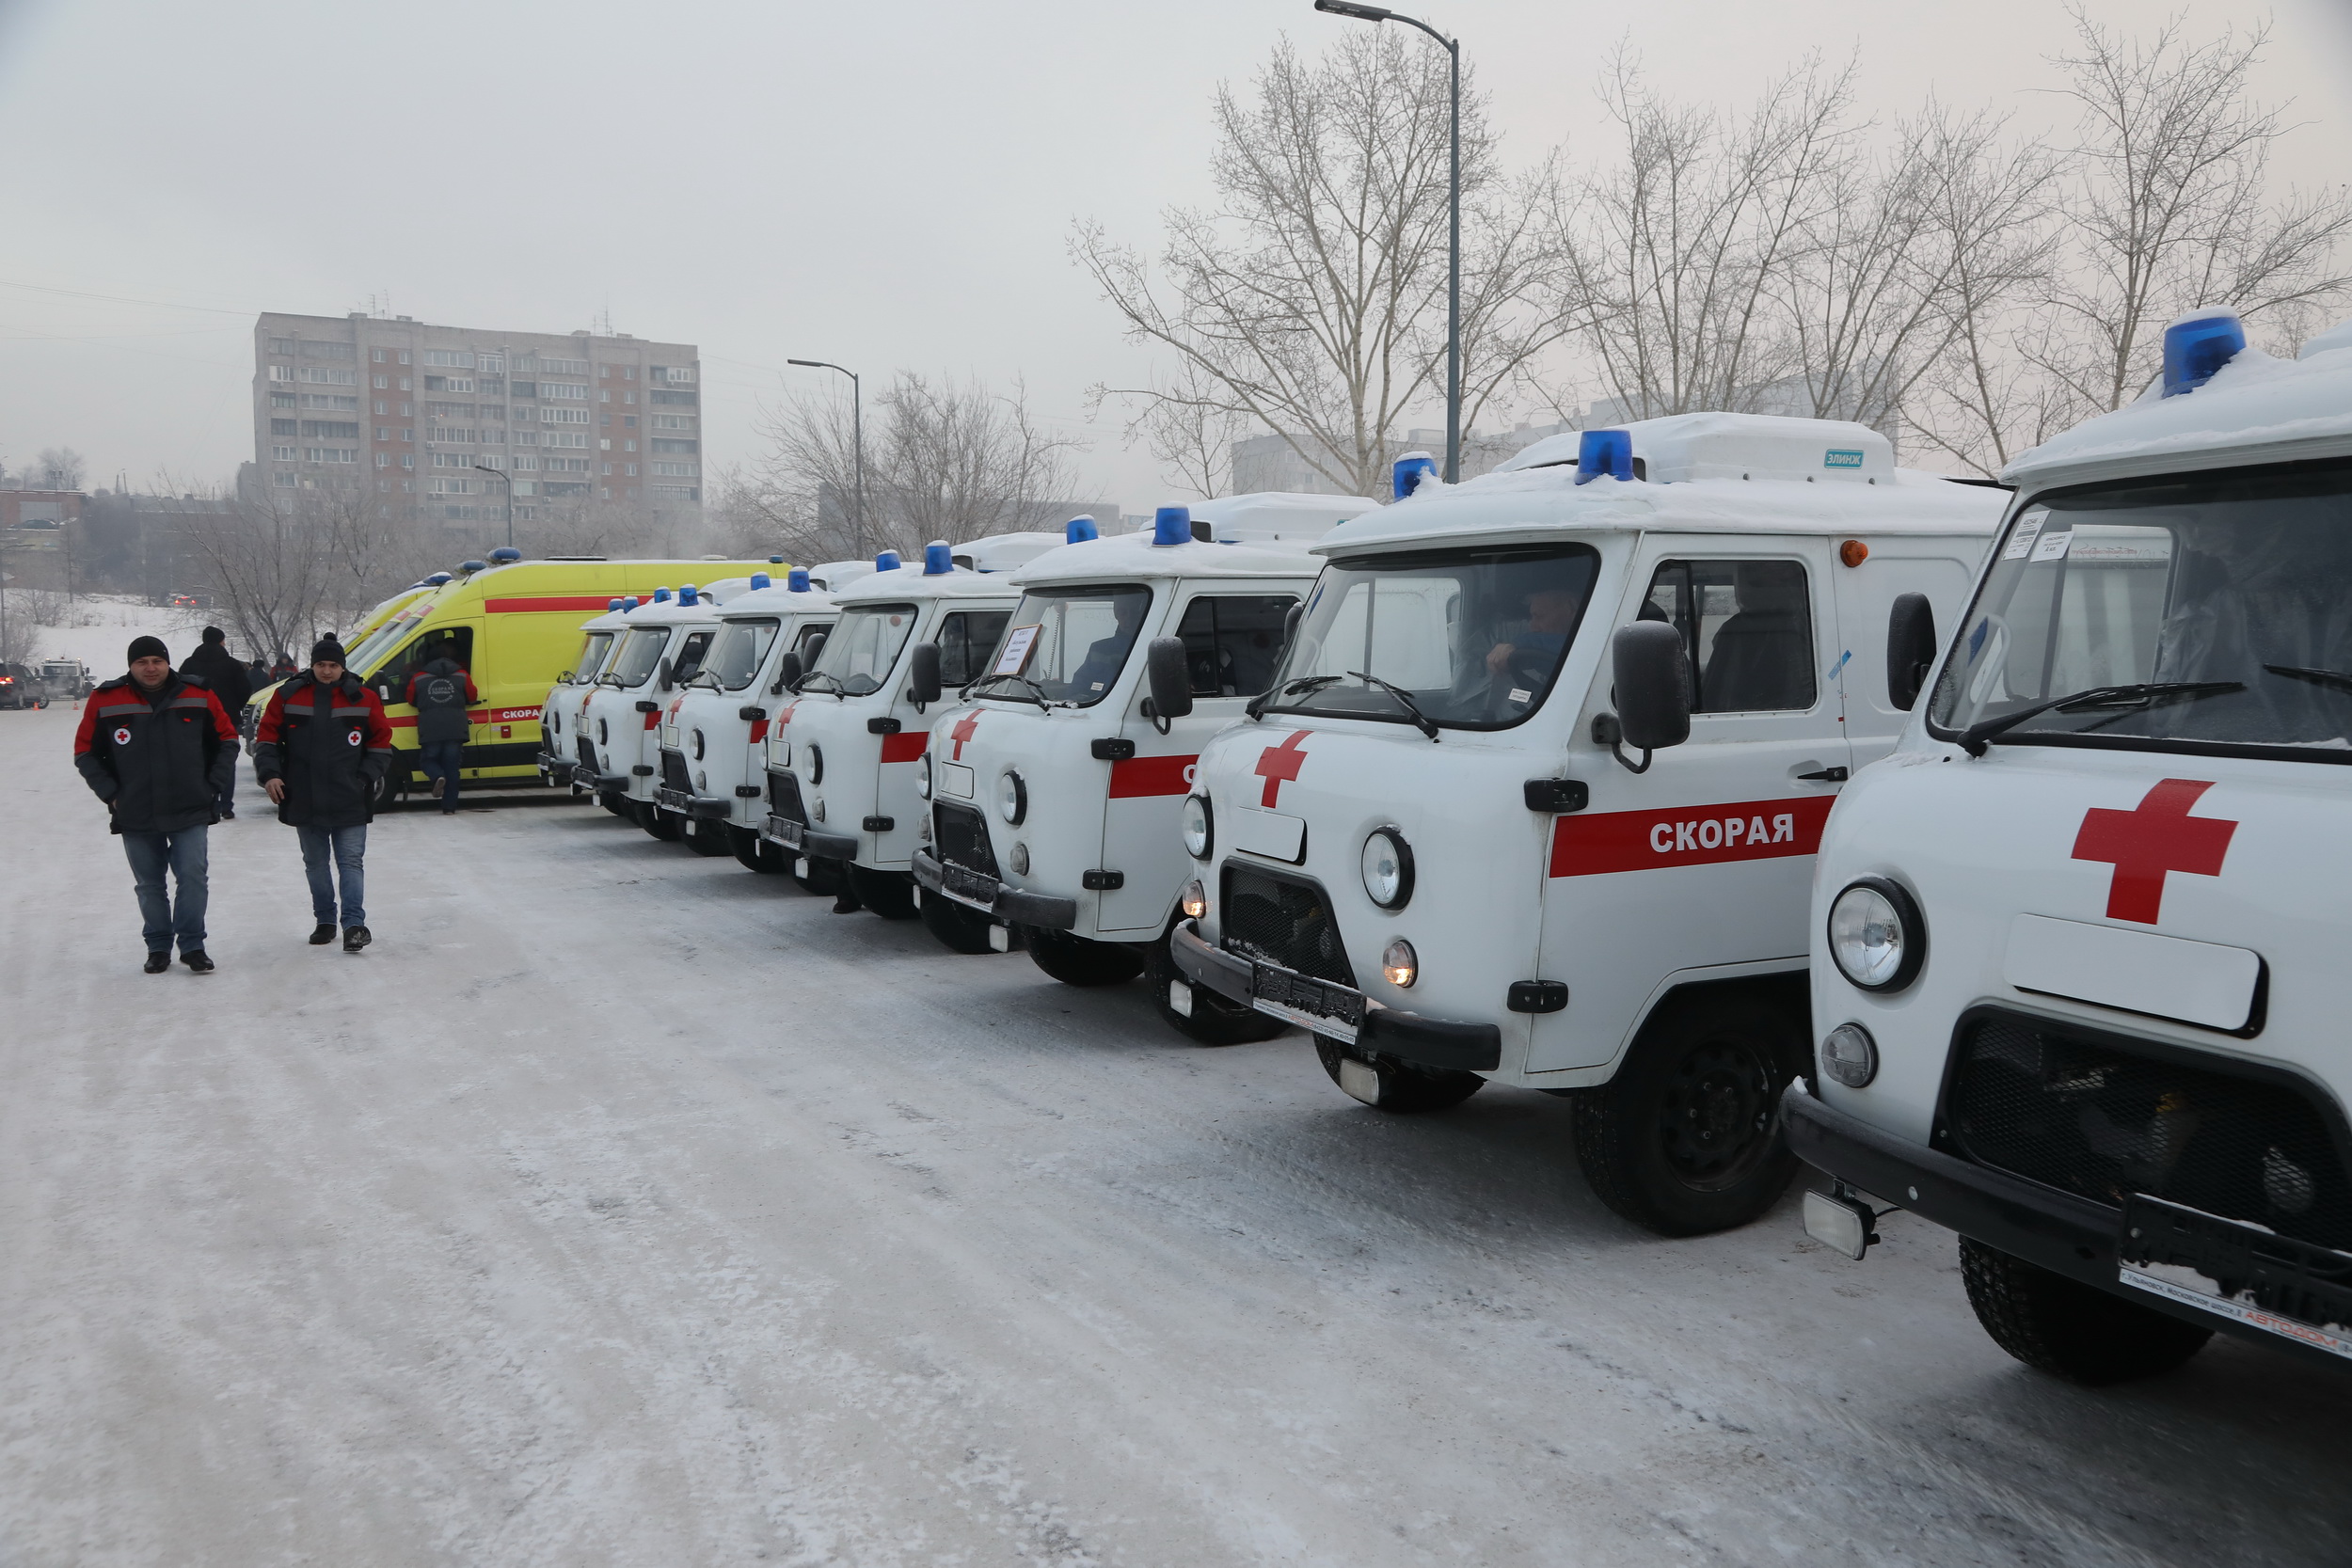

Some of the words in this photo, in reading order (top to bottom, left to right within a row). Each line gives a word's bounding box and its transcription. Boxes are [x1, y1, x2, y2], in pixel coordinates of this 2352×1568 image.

[1827, 453, 1862, 466] ЭЛИНЖ
[502, 709, 540, 719] СКОРА
[1650, 813, 1794, 853] СКОРАЯ
[2167, 1287, 2210, 1307] Московское
[2246, 1311, 2338, 1346] АВТОДОМ
